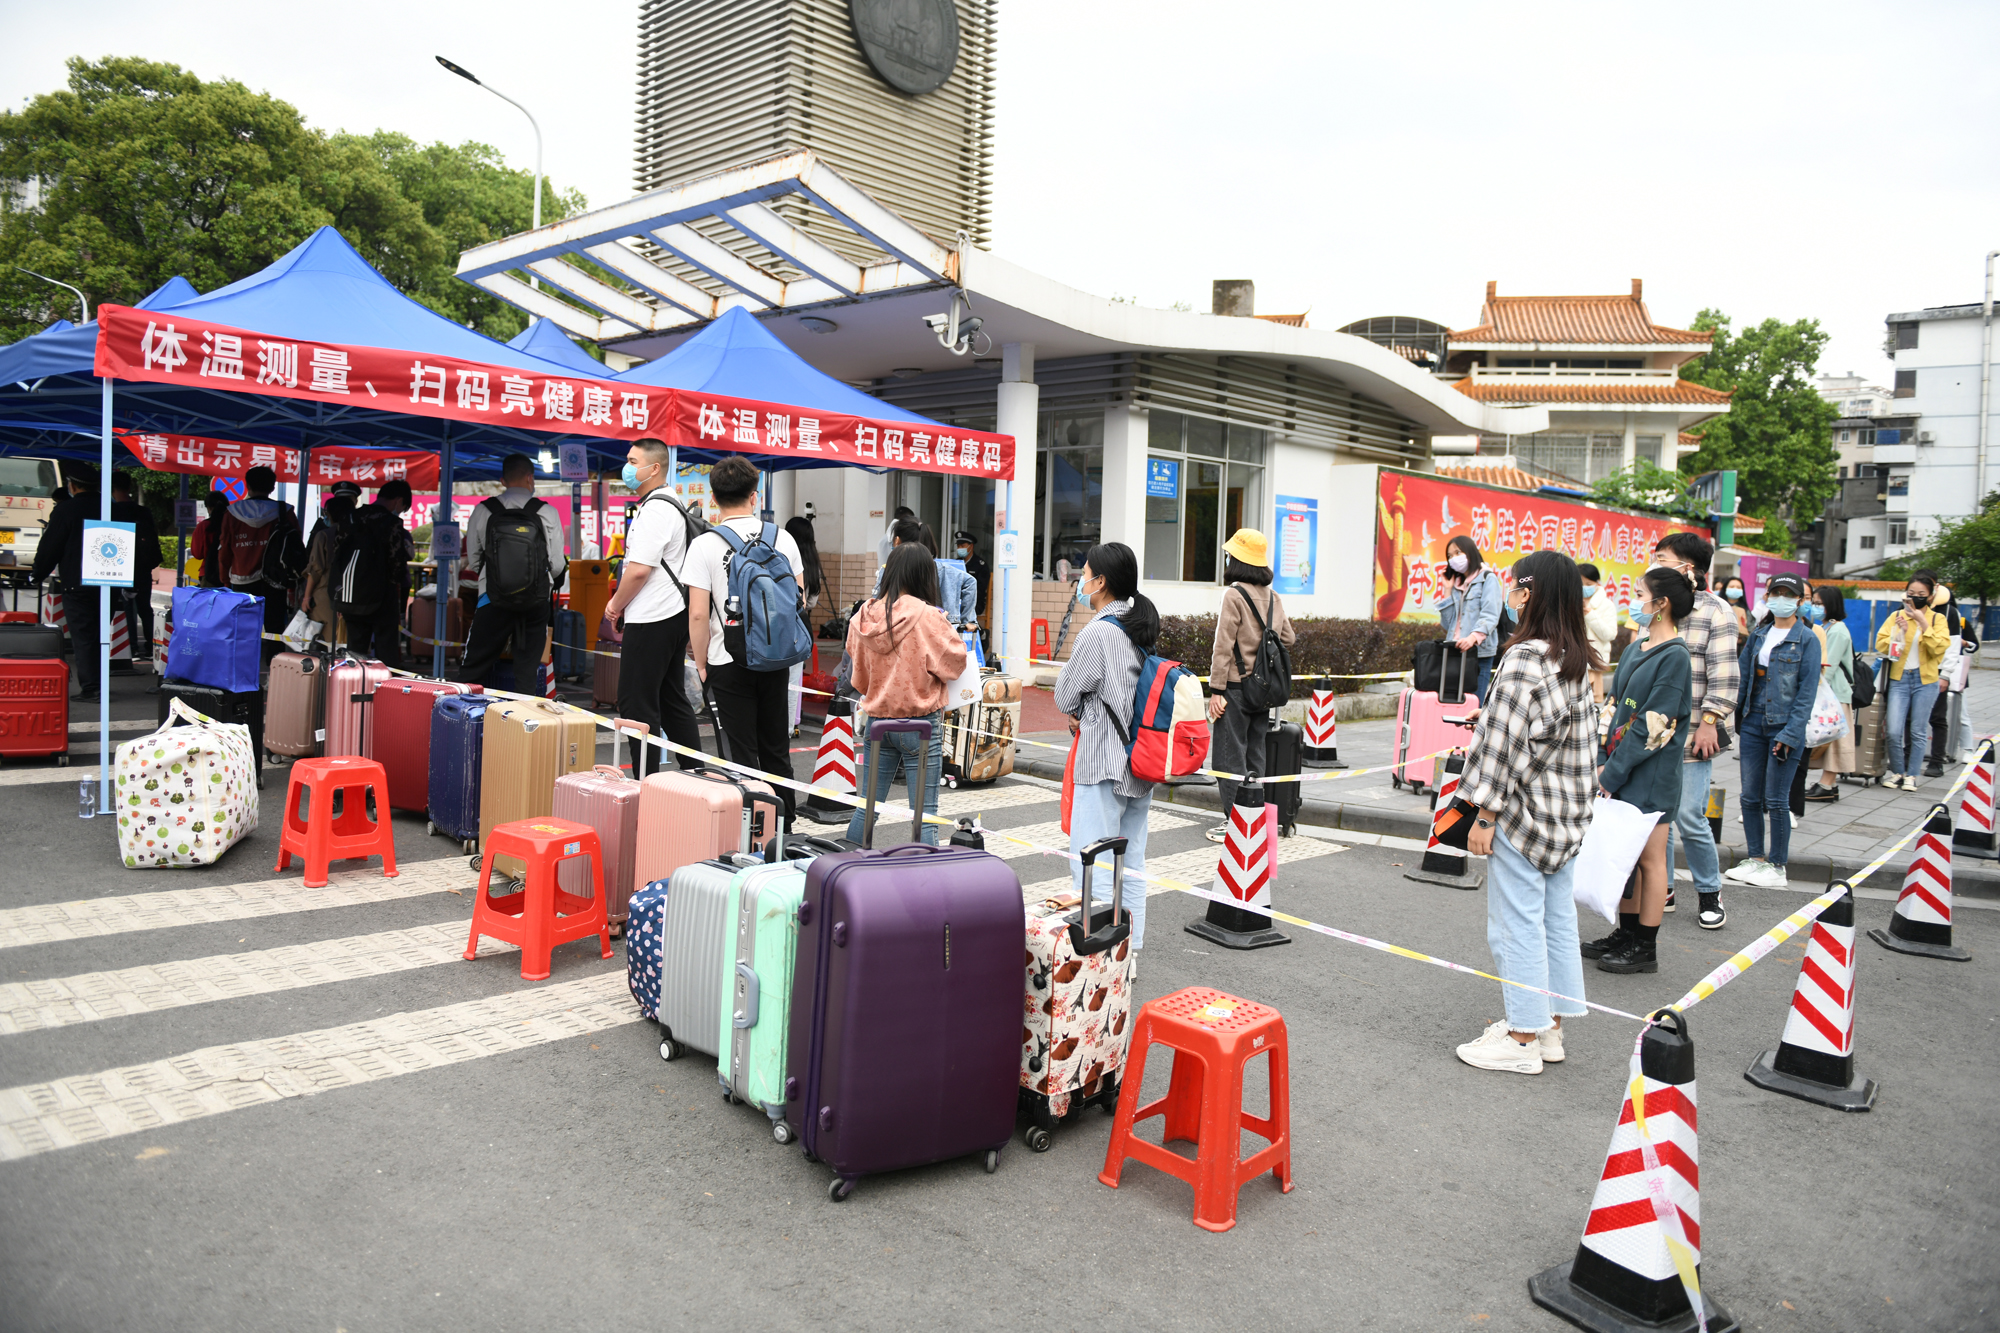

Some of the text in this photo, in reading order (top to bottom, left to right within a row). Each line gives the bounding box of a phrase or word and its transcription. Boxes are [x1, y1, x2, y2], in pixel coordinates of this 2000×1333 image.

[141, 320, 650, 431] 体温测量、扫码亮健康码
[138, 434, 408, 481] 请出示易班审核码
[698, 403, 1001, 472] 体温测量、扫码亮健康码
[0, 535, 14, 543] 06
[0, 712, 61, 737] STYLE
